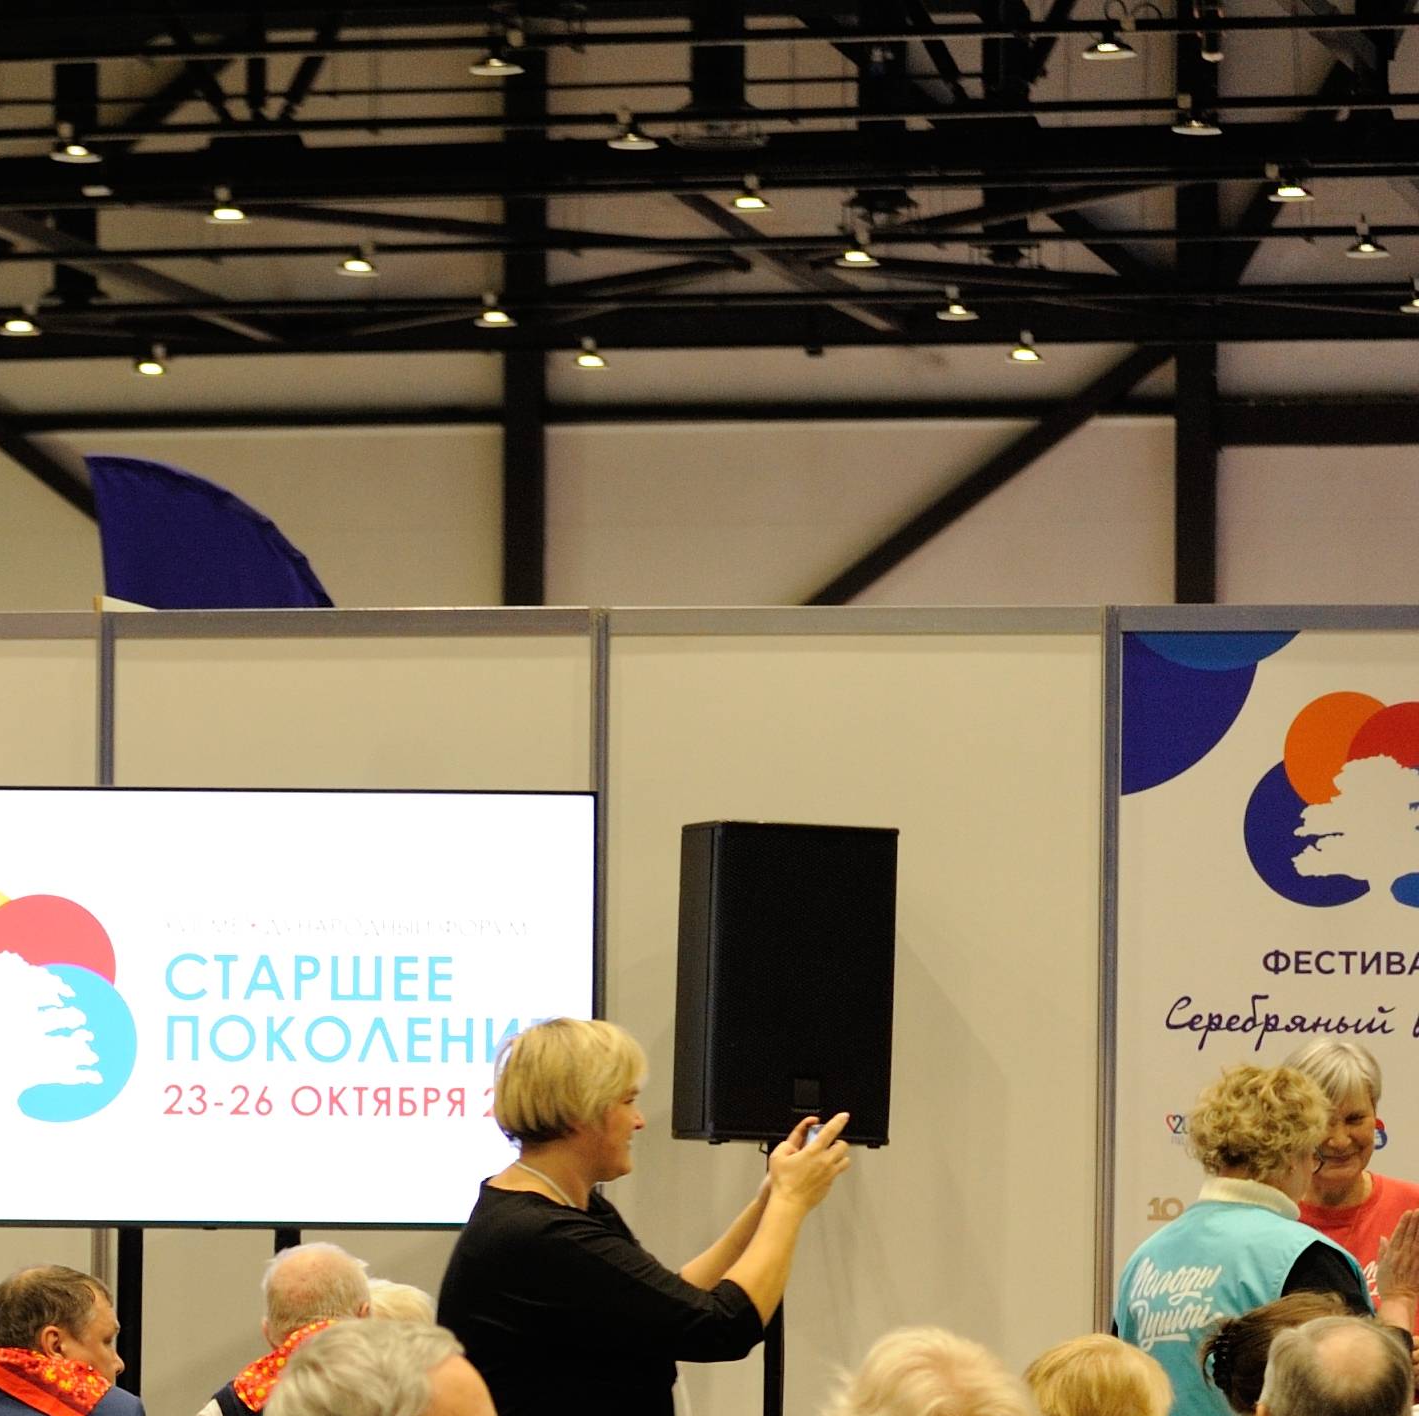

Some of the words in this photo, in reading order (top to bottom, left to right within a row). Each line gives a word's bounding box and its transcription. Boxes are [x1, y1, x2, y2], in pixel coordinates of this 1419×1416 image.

[165, 953, 453, 1001] СТАРШЕЕ
[1262, 950, 1419, 975] ФЕСТИВА
[166, 1014, 548, 1063] ПОКОЛЕНИ
[1165, 994, 1396, 1051] Серебряный
[163, 1085, 273, 1116] 23-26
[291, 1085, 465, 1117] ОКТЯБРЯ
